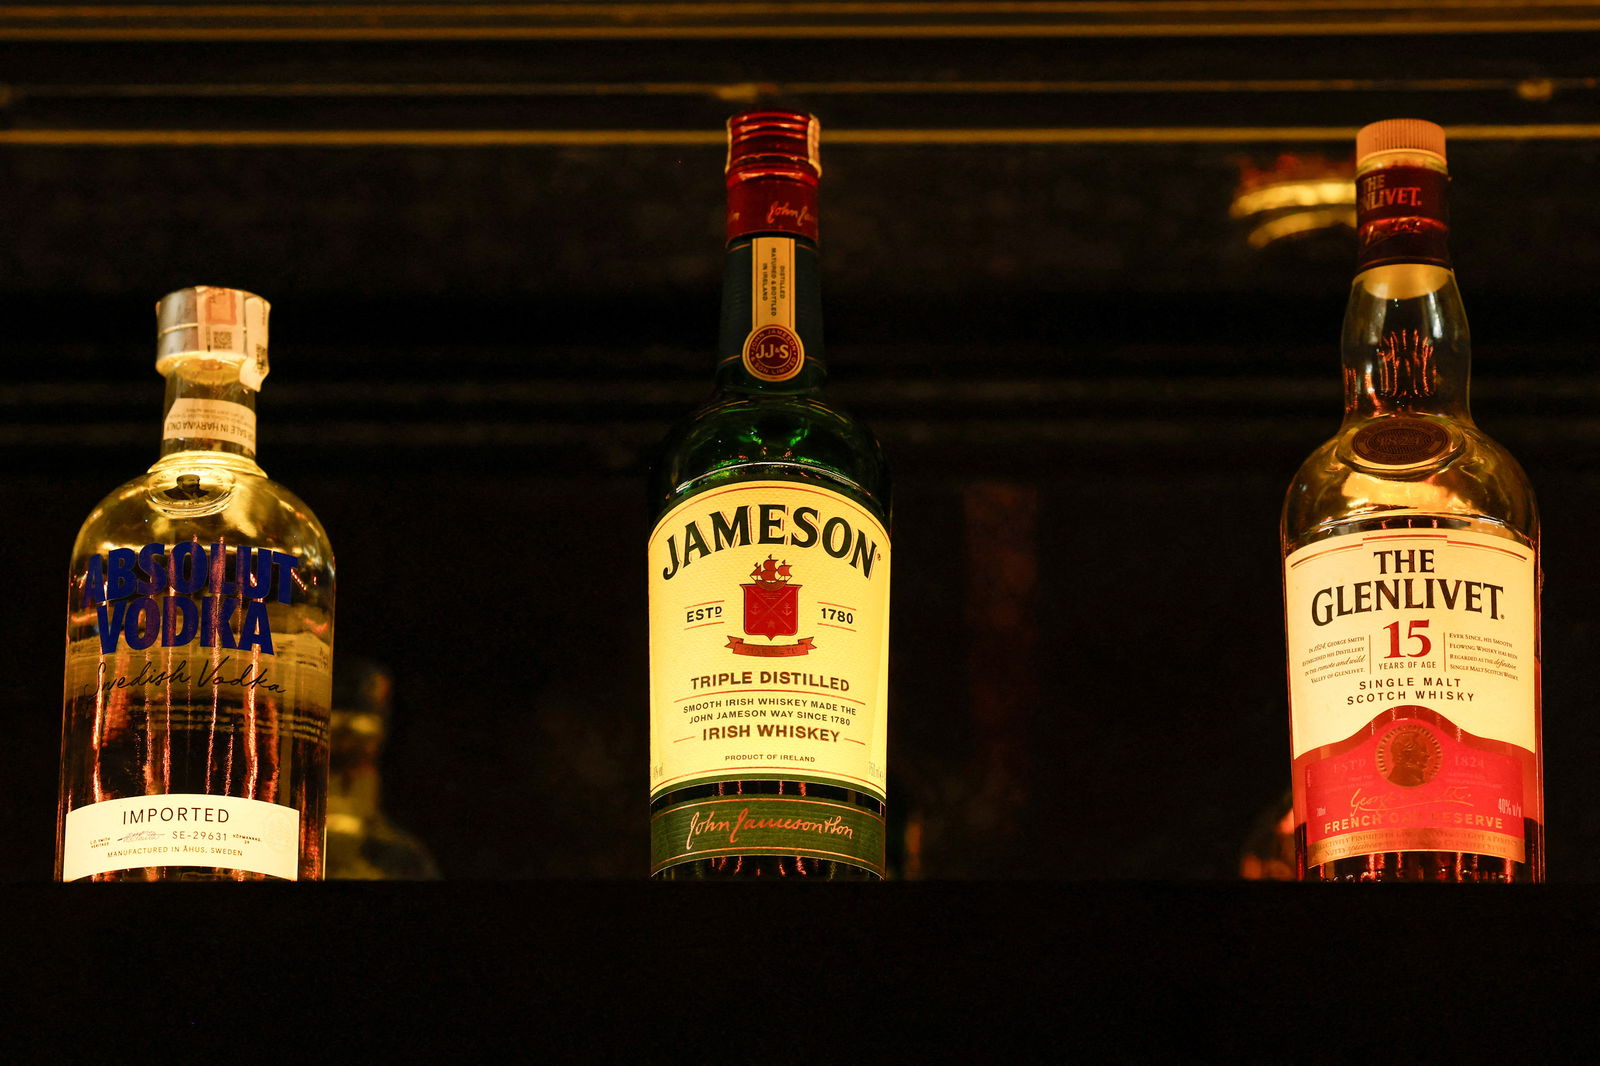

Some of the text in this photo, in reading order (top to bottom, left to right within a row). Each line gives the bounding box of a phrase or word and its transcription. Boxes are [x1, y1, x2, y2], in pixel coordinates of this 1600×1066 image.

[220, 422, 229, 433] IN
[231, 425, 248, 438] SALE
[662, 504, 878, 581] JAMESON
[1373, 549, 1435, 574] THE
[82, 541, 299, 608] ABSOLUT
[1311, 578, 1504, 627] GLENLIVET
[821, 606, 854, 625] 1780
[96, 596, 275, 655] VODKA
[1327, 638, 1347, 648] GEORGE
[1383, 619, 1432, 659] 15
[1335, 646, 1365, 656] DISTILLERY
[1476, 645, 1498, 655] WHISKY
[1378, 661, 1437, 670] YEARS OF AGE
[85, 655, 286, 700] Swedish Vodka
[691, 671, 850, 692] TRIPLE DISTILLED
[1359, 677, 1461, 690] SINGLE MALT
[683, 698, 856, 716] SMOOTH IRISH WHISKEY MADE THE
[1347, 690, 1475, 706] SCOTCH WHISKY
[689, 710, 851, 726] JOHN JAMESON WAY SINCE 1780
[703, 724, 841, 743] IRISH WHISKEY
[724, 753, 764, 761] PRODUCT
[780, 754, 816, 763] IRELAND
[123, 807, 230, 825] IMPORTED
[1324, 814, 1383, 835] FRENCH
[1429, 811, 1504, 829] ESERVE
[172, 831, 227, 842] SE-29631
[686, 811, 730, 850] John
[107, 846, 169, 858] MANUFACTURED
[183, 844, 208, 854] ÅHUS,
[211, 847, 243, 856] SWEDEN
